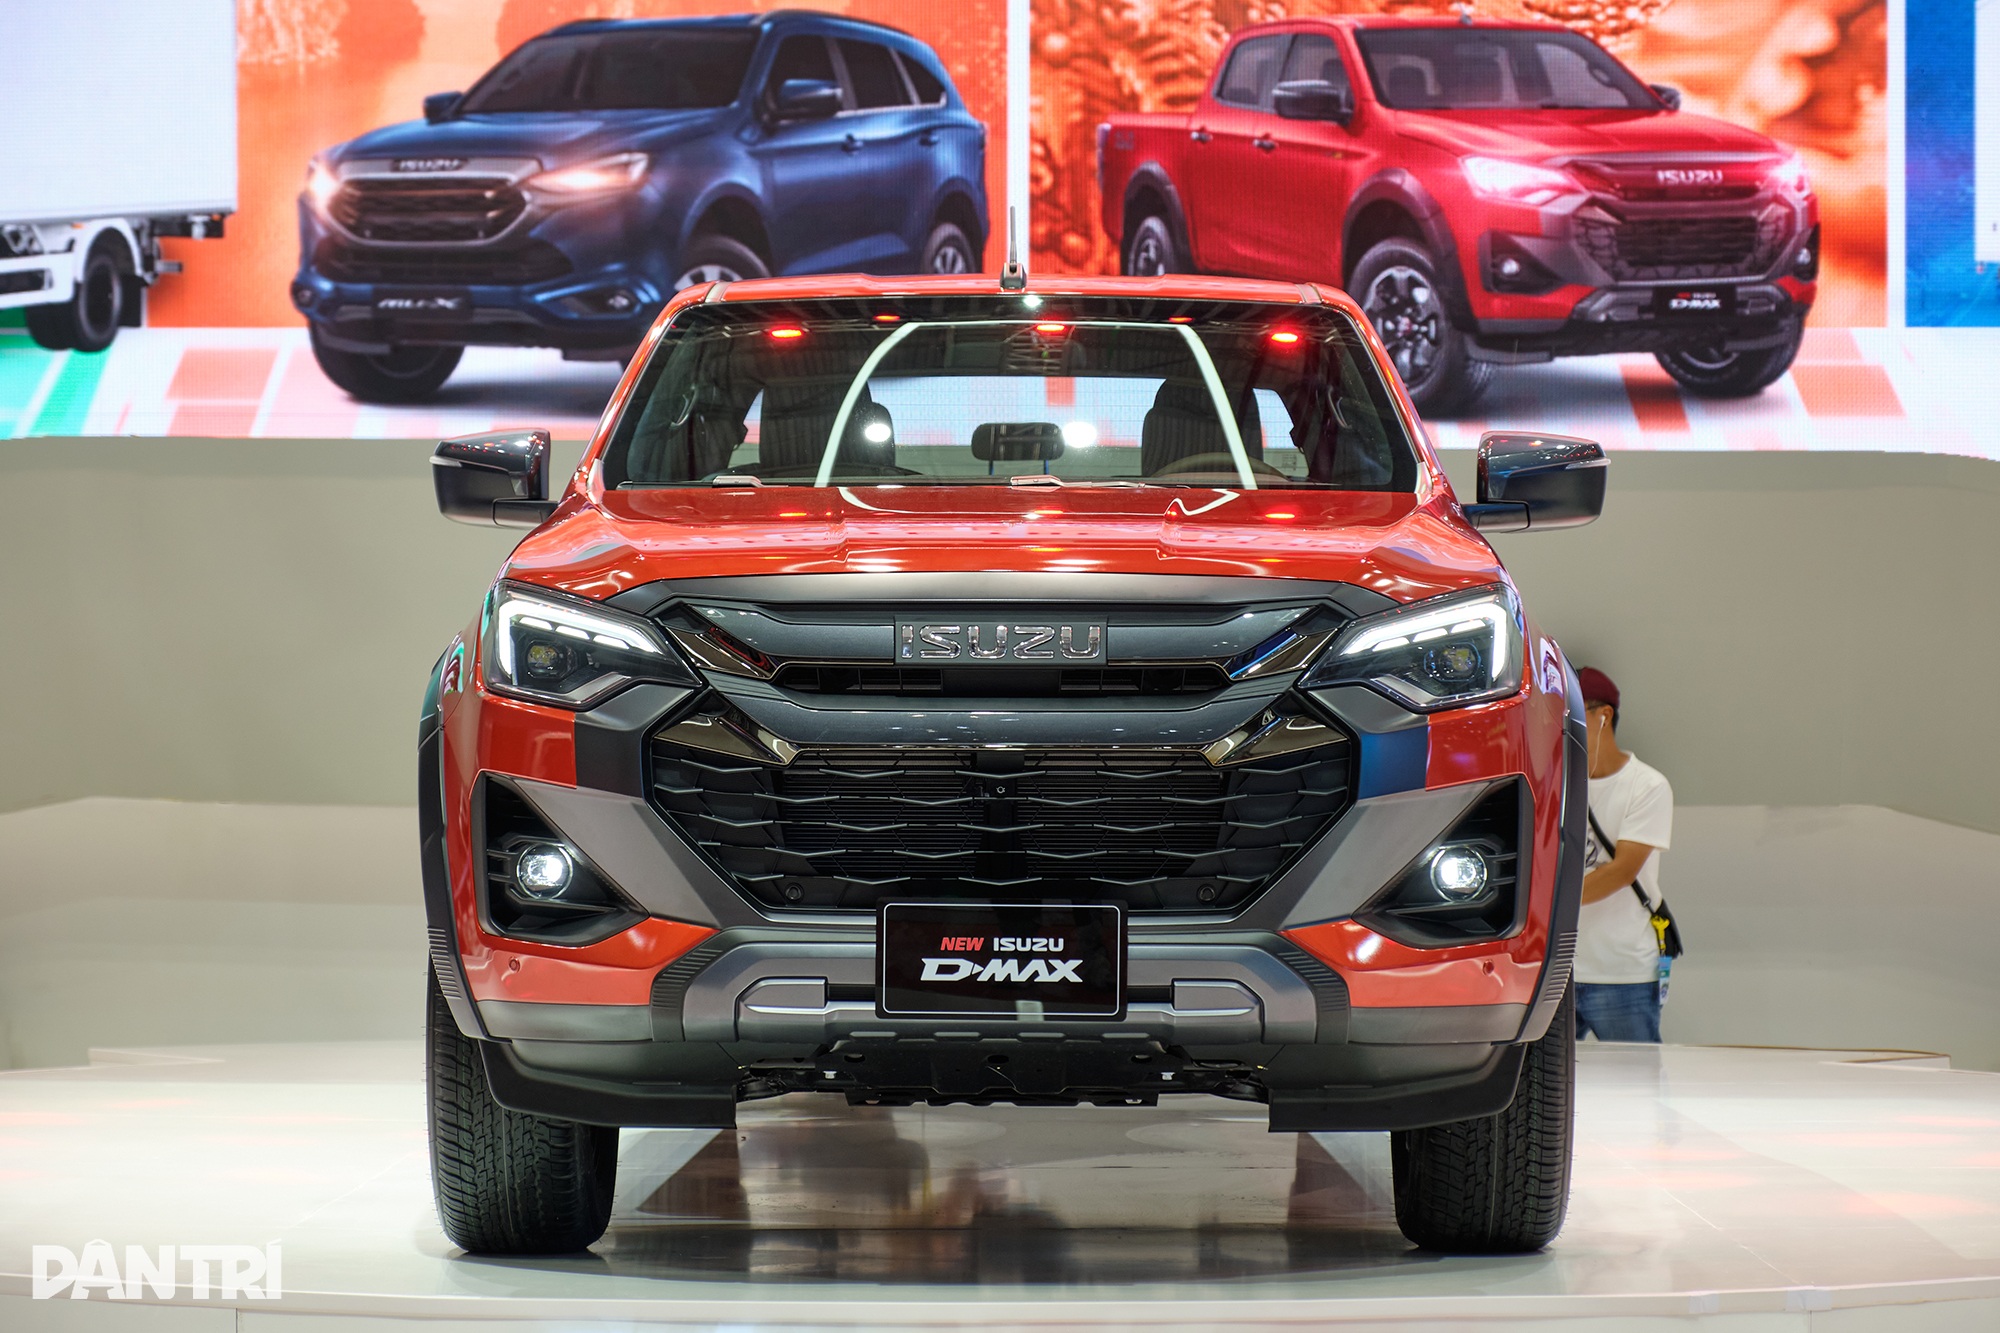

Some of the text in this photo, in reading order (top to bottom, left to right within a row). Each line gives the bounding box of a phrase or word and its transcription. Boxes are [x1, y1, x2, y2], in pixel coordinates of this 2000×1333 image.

[1657, 169, 1723, 184] ISUZU
[902, 625, 1101, 659] ISUZU
[940, 937, 1064, 952] NEW ISUZU
[920, 958, 1083, 983] D-MAX
